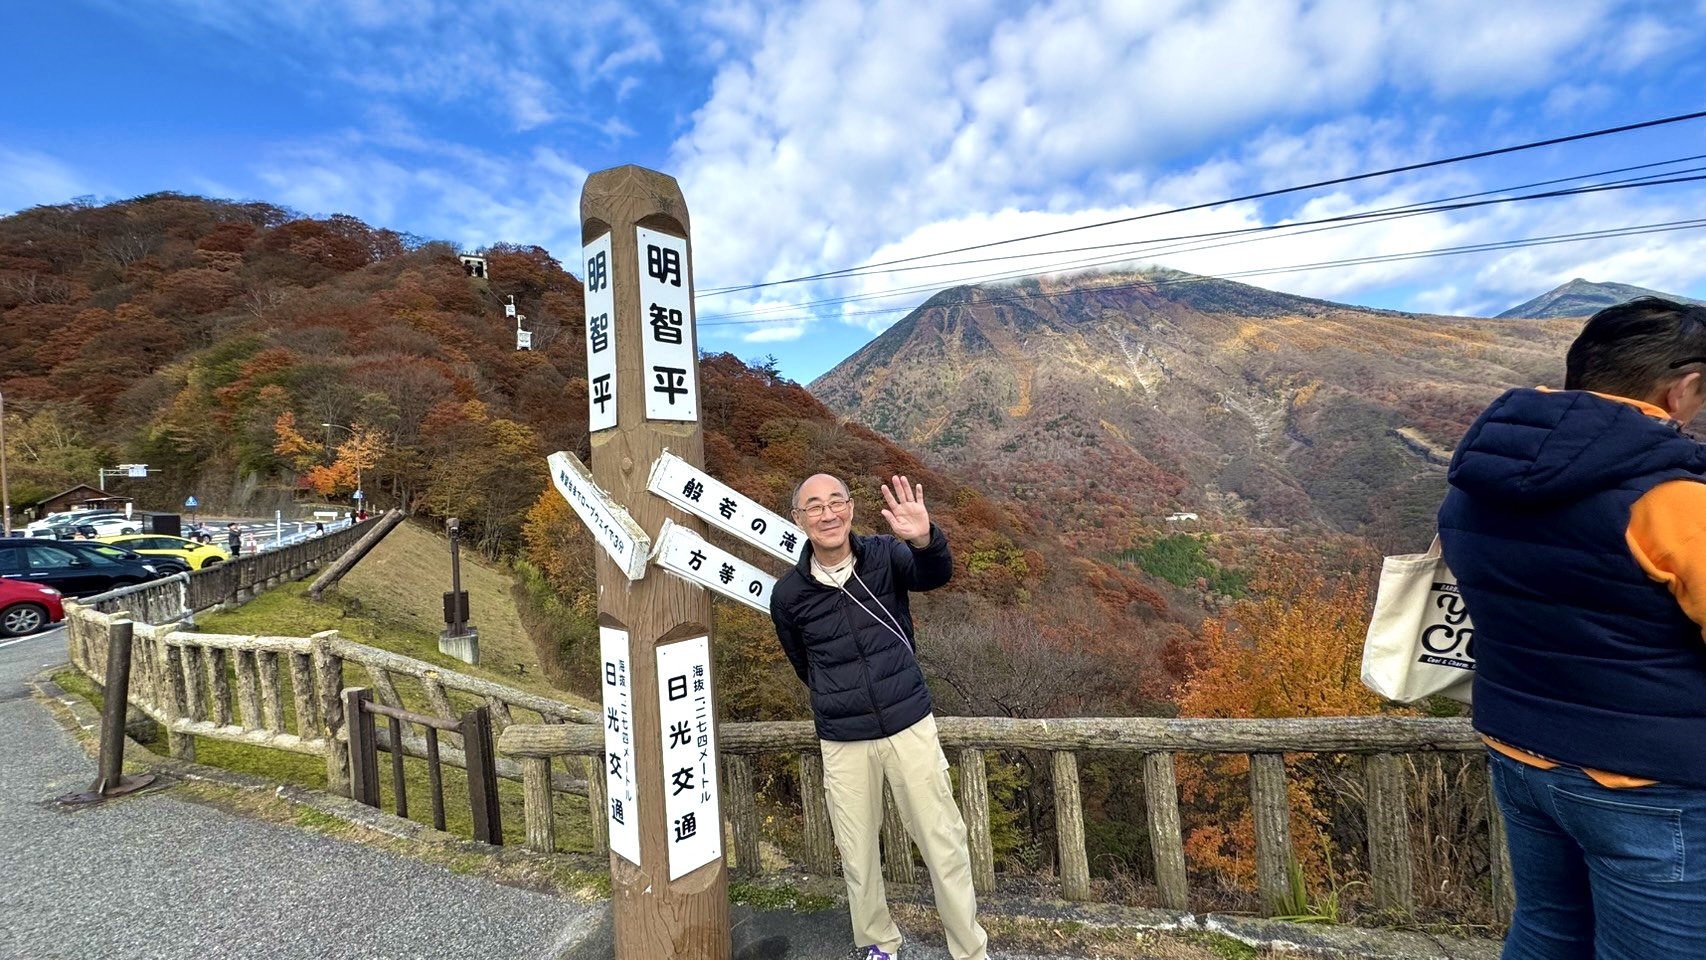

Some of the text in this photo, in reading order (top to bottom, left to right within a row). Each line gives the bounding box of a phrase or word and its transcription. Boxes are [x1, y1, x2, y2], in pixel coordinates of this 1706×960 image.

[588, 250, 612, 414] 明智平
[646, 244, 688, 405] 明智平
[682, 477, 797, 554] 般若の滝
[606, 662, 625, 826] 日光交通
[668, 674, 697, 843] 日光交通
